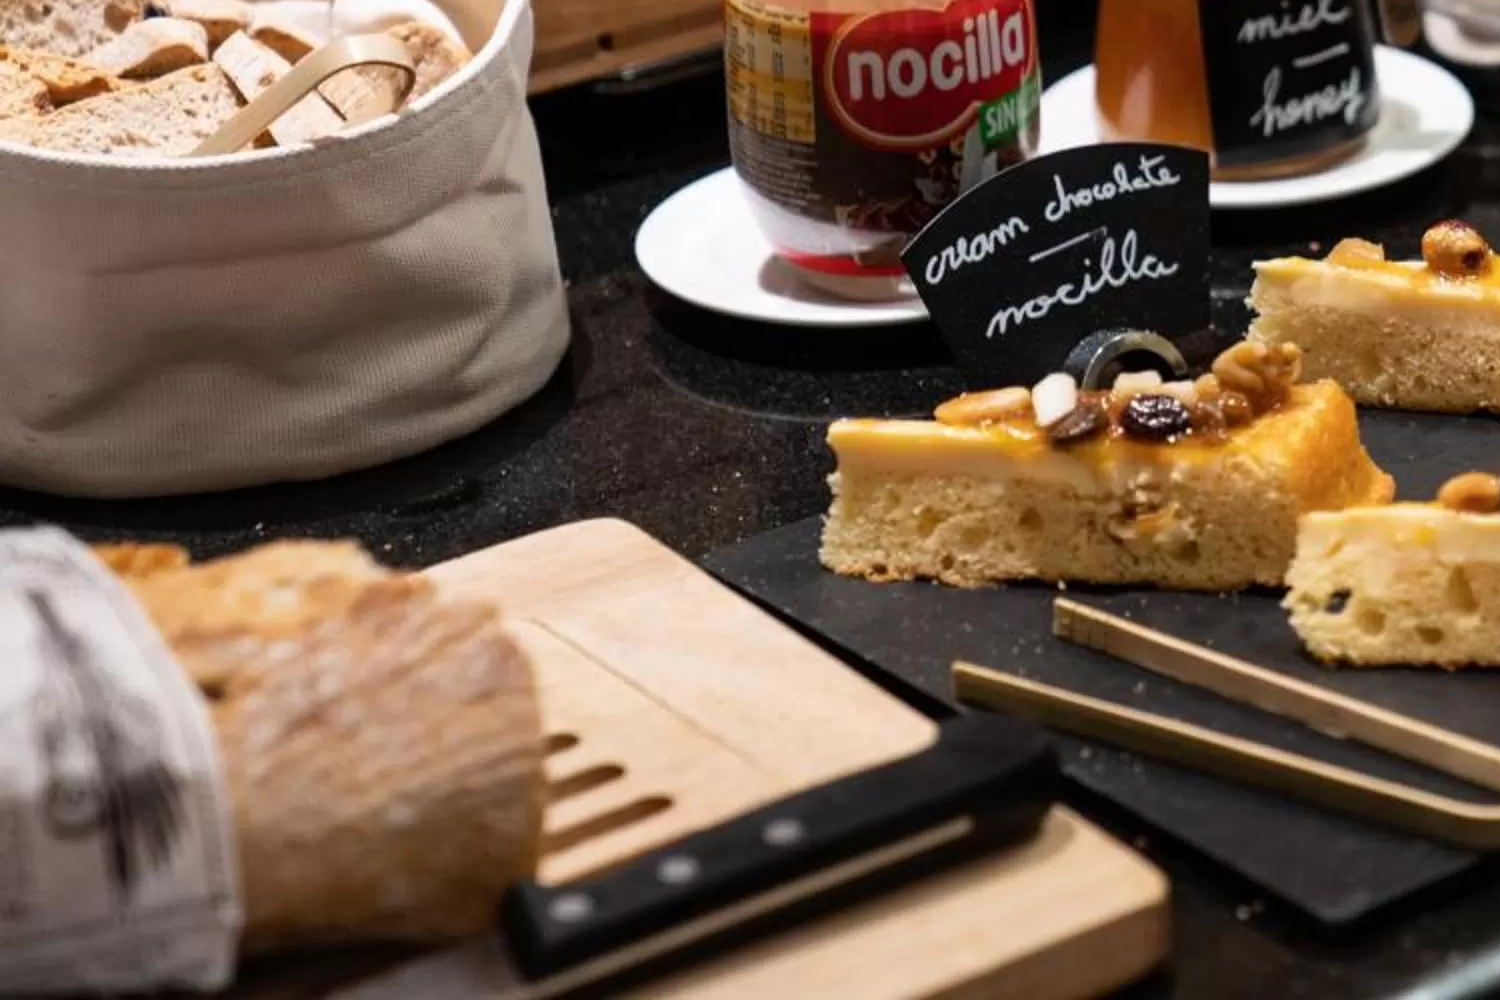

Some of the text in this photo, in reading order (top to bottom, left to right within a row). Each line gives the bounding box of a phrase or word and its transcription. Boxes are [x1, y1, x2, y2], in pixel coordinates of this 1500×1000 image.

[848, 8, 1025, 101] nocilla
[985, 95, 1016, 139] SIN
[1249, 66, 1364, 138] honey
[925, 154, 1182, 285] cream chocolate
[985, 228, 1179, 339] nocilla
